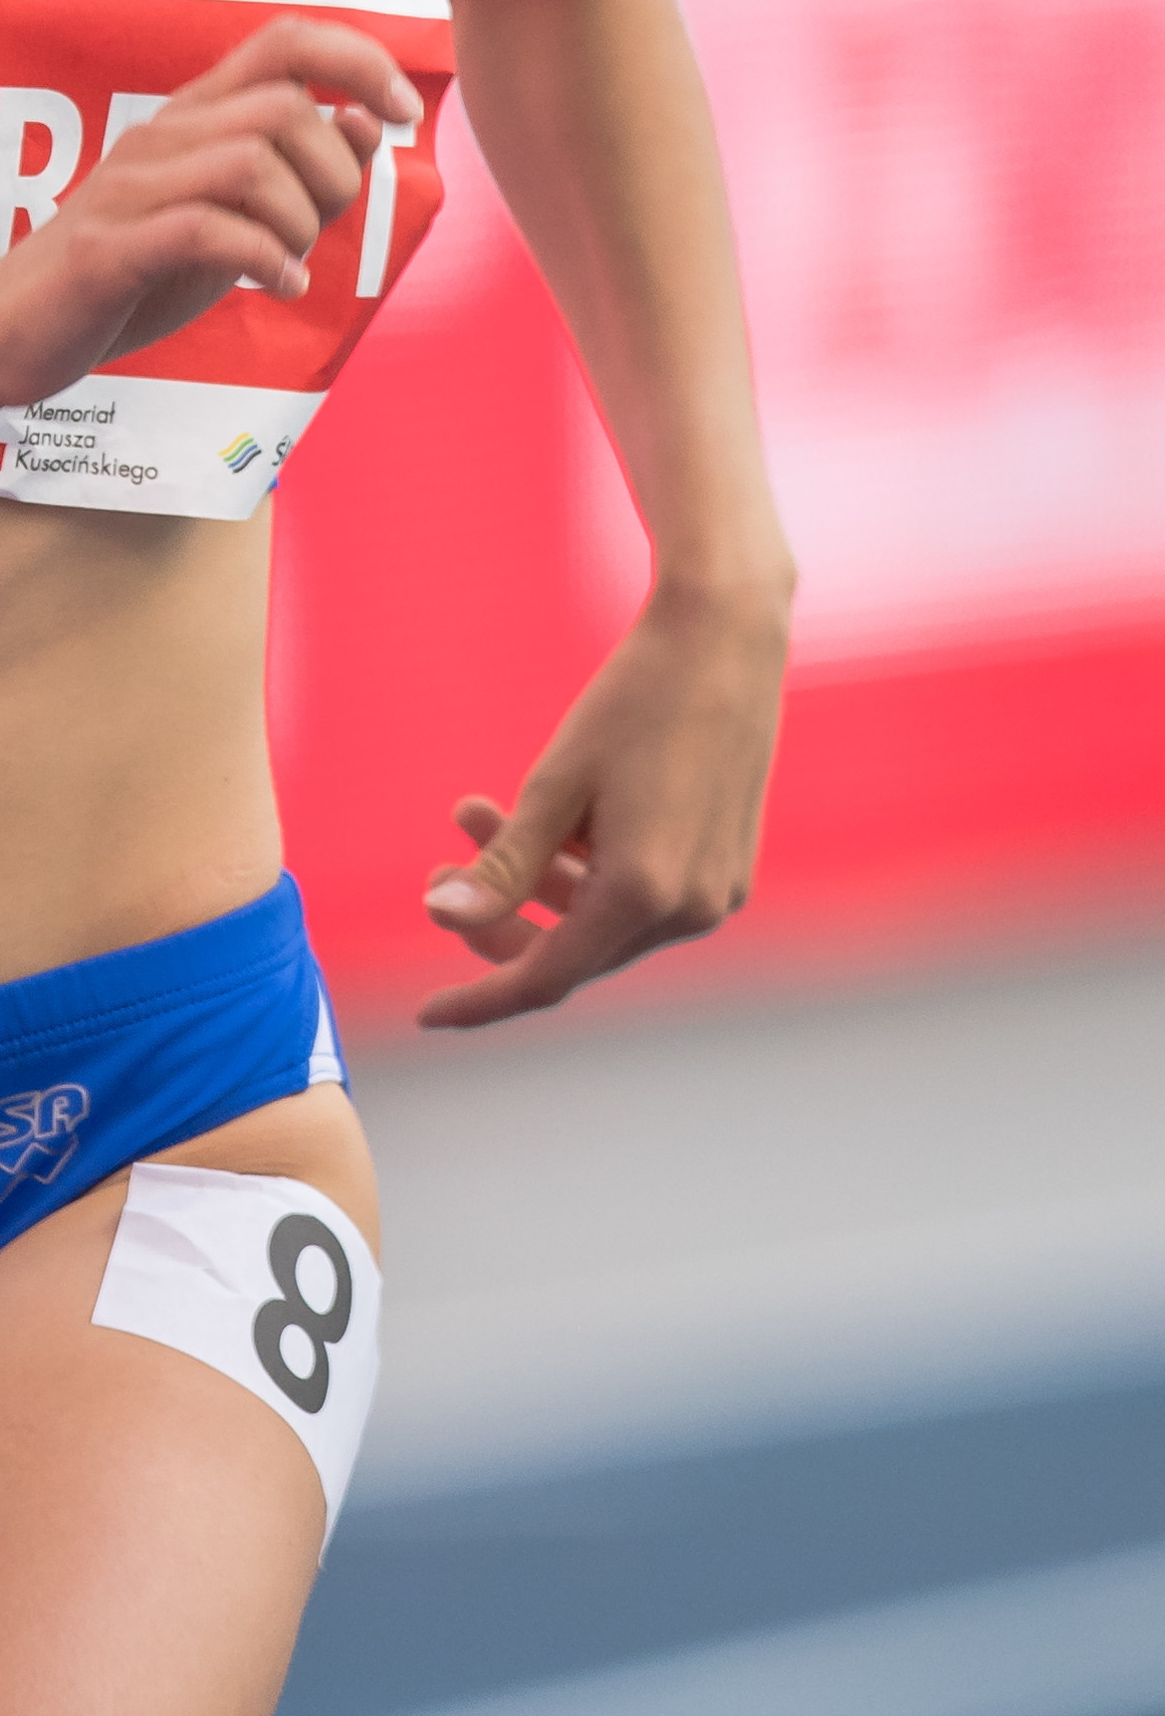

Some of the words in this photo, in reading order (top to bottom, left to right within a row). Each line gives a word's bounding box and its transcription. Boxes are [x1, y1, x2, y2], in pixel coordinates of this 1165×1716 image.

[24, 401, 116, 424] Memoriał
[18, 425, 96, 449] Janusza
[15, 448, 159, 485] Kusocińskiego
[251, 1212, 353, 1415] 8
